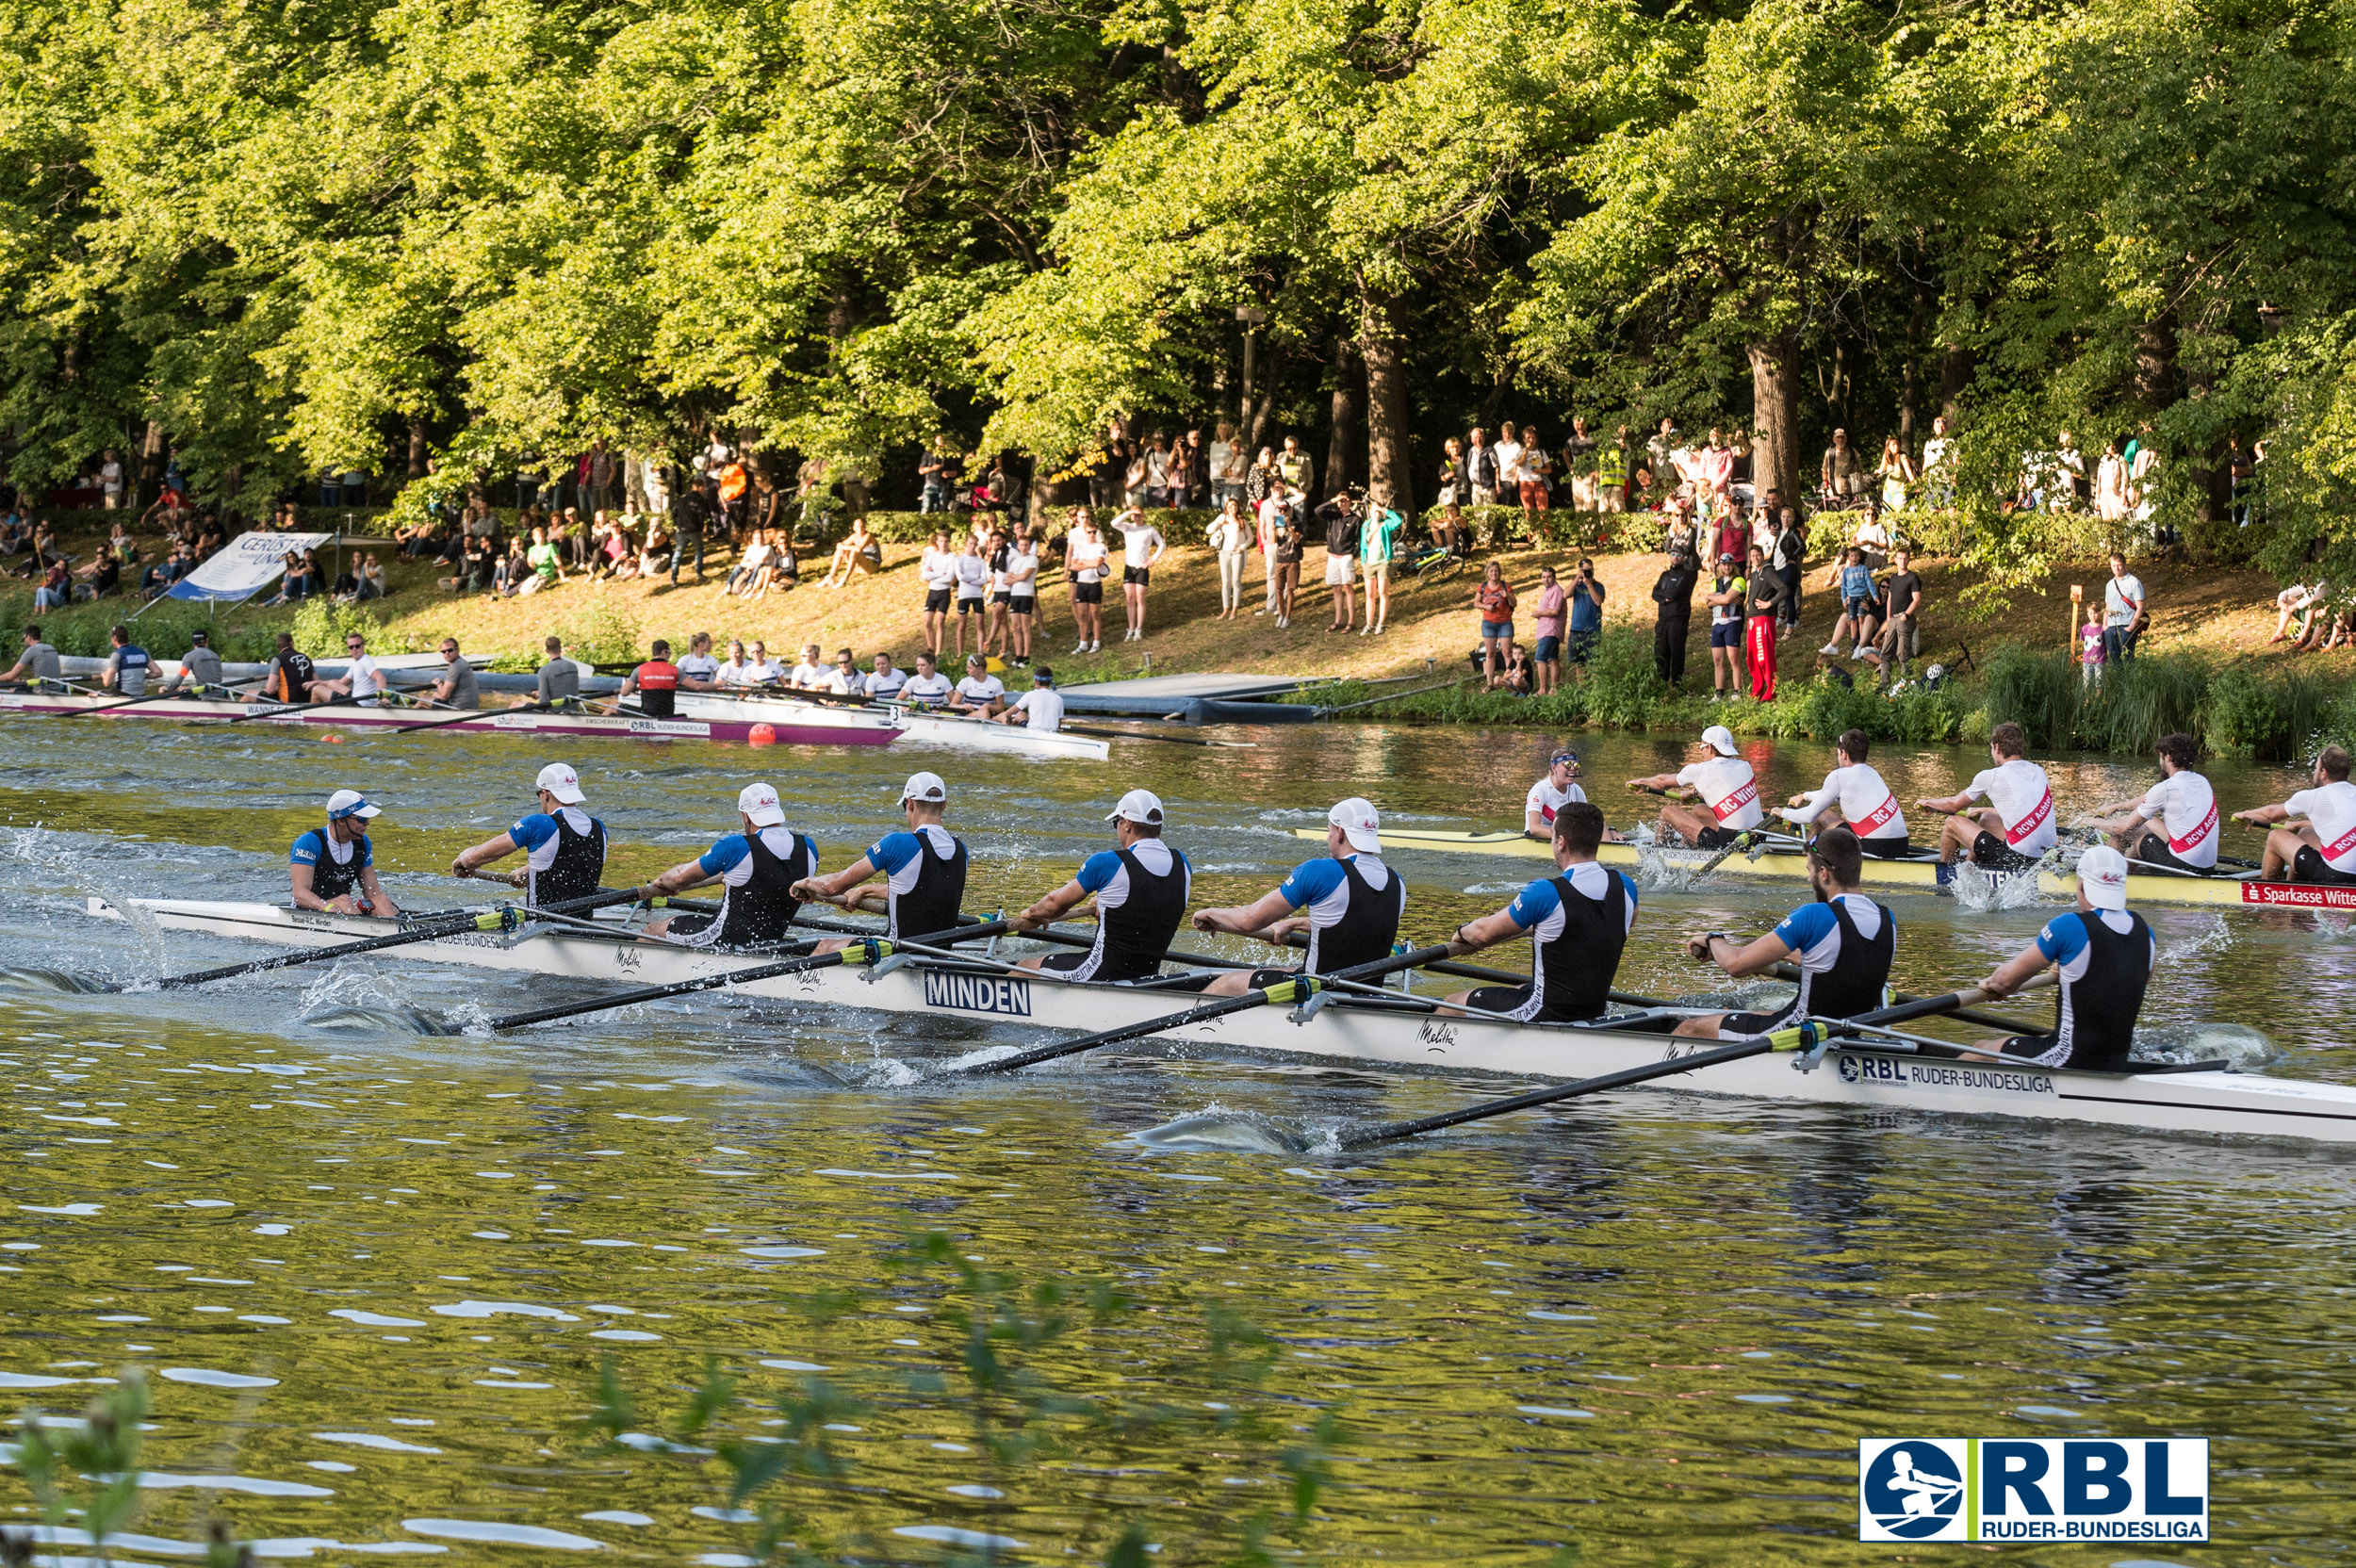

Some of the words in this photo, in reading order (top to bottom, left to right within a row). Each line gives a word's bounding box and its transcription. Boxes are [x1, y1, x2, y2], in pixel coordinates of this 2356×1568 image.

[1756, 626, 1765, 662] HOLLISTER
[892, 707, 899, 721] 3
[639, 721, 656, 730] RBL
[657, 724, 709, 732] RUDER-BUNDESLIGA
[1719, 798, 1738, 815] RC
[1870, 808, 1890, 825] RC
[2016, 817, 2036, 836] RCW
[2184, 826, 2205, 845] RCW
[2334, 832, 2356, 852] RCW
[2264, 887, 2322, 904] Sparkasse
[614, 943, 642, 969] Melitta
[927, 972, 1028, 1015] MINDEN
[1415, 1018, 1455, 1047] Melitta
[1861, 1057, 1907, 1081] RBL
[1912, 1066, 2054, 1093] RUDER-BUNDESLIGA
